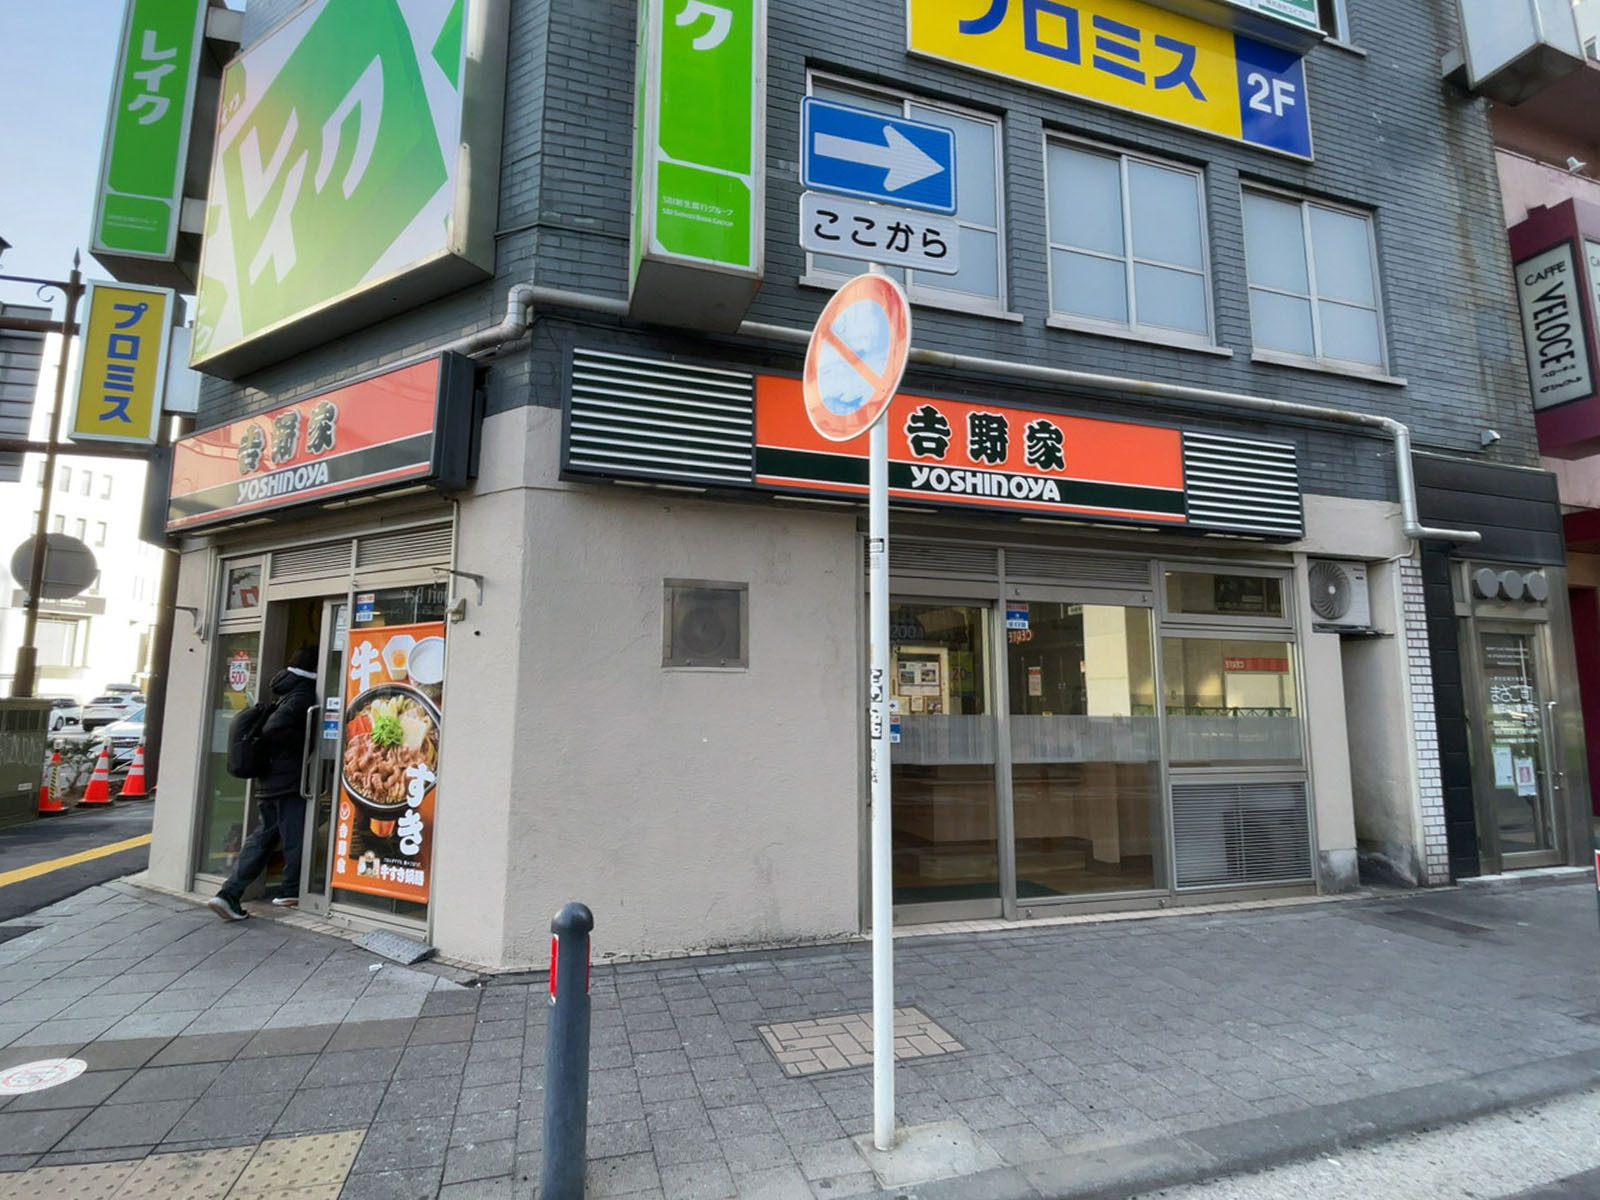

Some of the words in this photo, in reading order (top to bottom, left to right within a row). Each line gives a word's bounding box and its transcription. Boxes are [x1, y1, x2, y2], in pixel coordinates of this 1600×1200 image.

[127, 29, 177, 126] レイク
[1247, 72, 1296, 118] 2F
[239, 53, 385, 285] レイク
[813, 209, 948, 259] ここから
[1532, 281, 1576, 369] VELOCE
[98, 302, 149, 423] プロミス
[905, 404, 1066, 472] 吉野家
[236, 461, 329, 504] YOSHINOYA
[910, 465, 1062, 502] YOSHINOYA
[351, 640, 382, 692] 牛
[397, 763, 437, 856] すき
